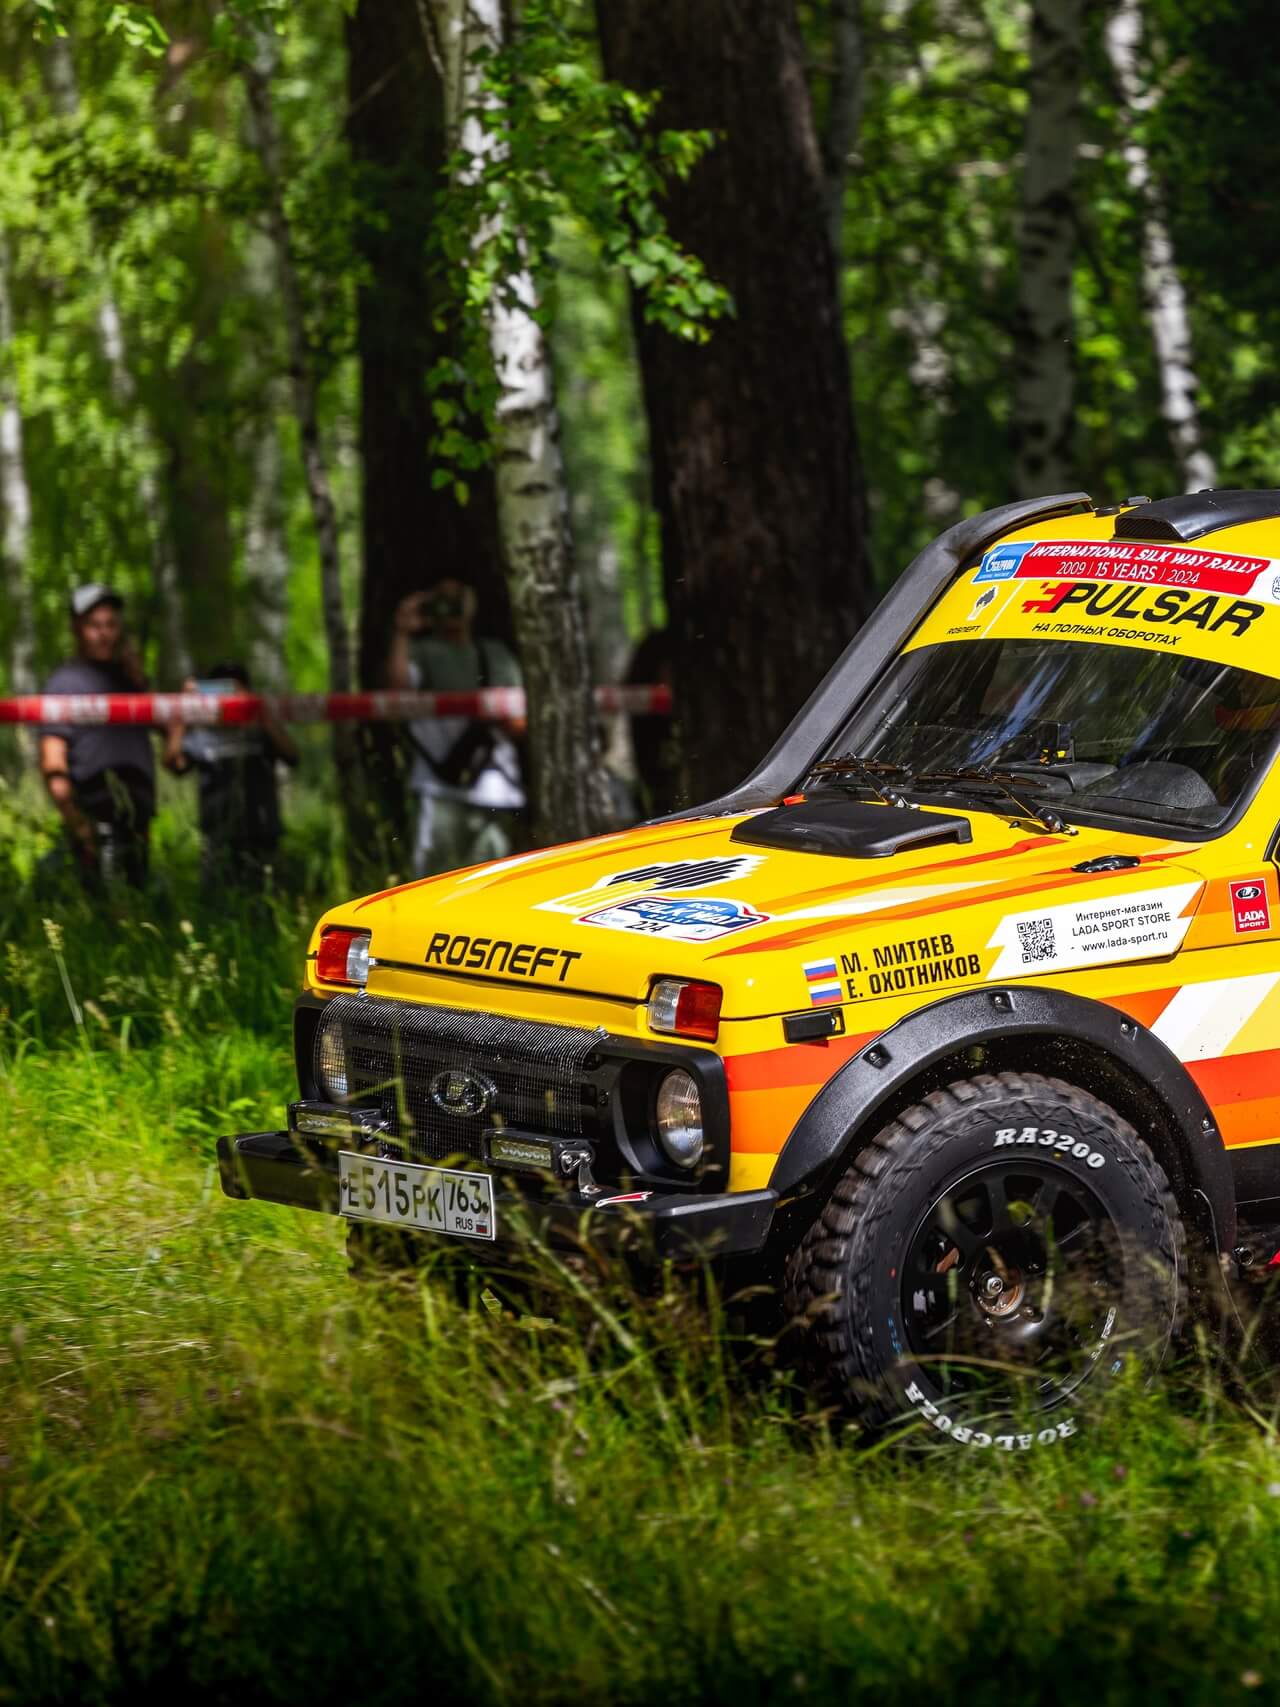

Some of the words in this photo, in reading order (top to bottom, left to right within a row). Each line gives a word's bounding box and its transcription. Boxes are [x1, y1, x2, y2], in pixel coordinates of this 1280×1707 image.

[1030, 545, 1134, 560] INTERNATIONAL
[1135, 549, 1172, 563] SILK
[1171, 553, 1209, 567] WAY
[1207, 558, 1262, 574] RALLY
[1056, 561, 1086, 575] 2009
[1097, 562, 1109, 576] 15
[1112, 562, 1158, 581] YEARS
[1167, 569, 1200, 585] 2024
[1052, 582, 1265, 637] PULSAR
[1032, 623, 1050, 632] НА
[1051, 623, 1108, 636] ПОЛНЫХ
[1107, 626, 1182, 645] ОБОРОТАХ
[1075, 901, 1163, 922] Интернет-магазин
[1238, 910, 1265, 922] LADA
[625, 920, 670, 933] 224
[1072, 922, 1100, 937] LADA
[1101, 917, 1135, 932] SPORT
[1138, 912, 1171, 925] STORE
[1239, 920, 1265, 928] SPORT
[1081, 930, 1169, 952] www.lada-sport.ru
[425, 932, 582, 982] ROSNEFT
[840, 952, 868, 975] М.
[872, 934, 955, 968] МИТЯЕВ
[846, 978, 863, 999] Е.
[869, 954, 981, 994] ОХОТНИКОВ
[993, 1128, 1106, 1169] RA3200
[444, 1175, 483, 1214] 763
[455, 1217, 473, 1231] RUS
